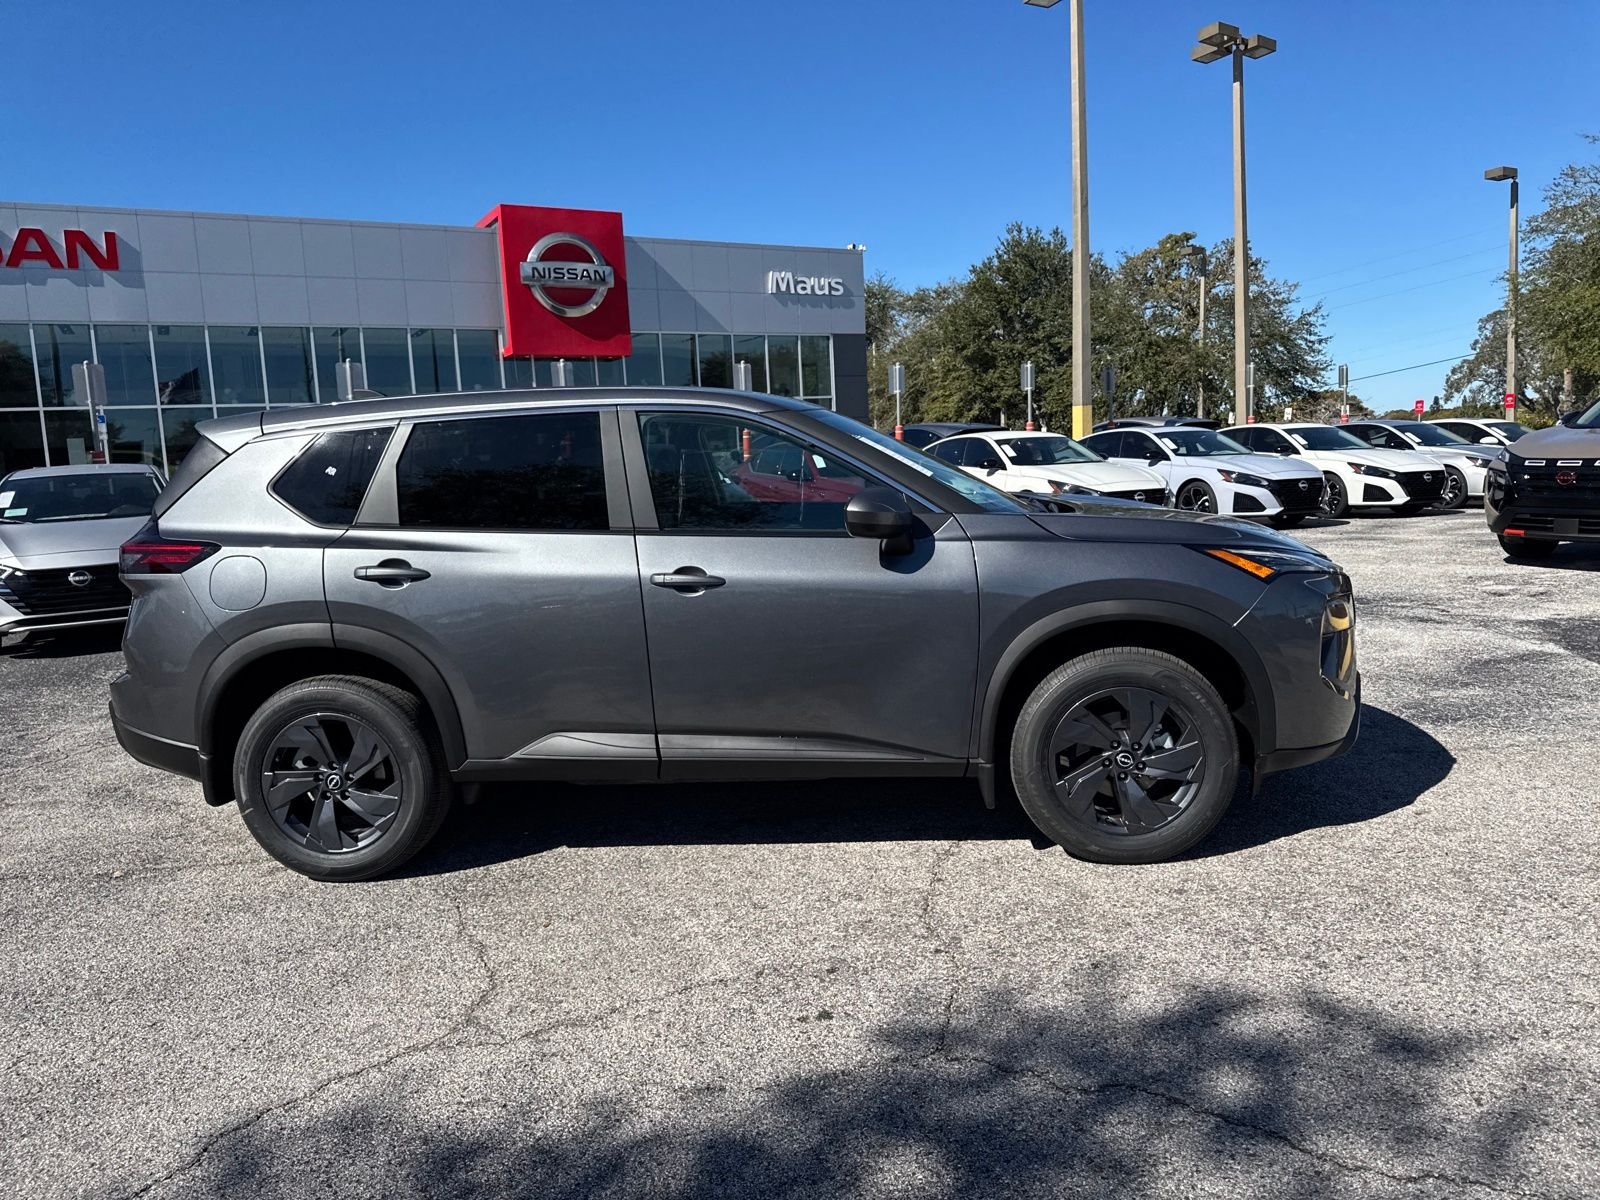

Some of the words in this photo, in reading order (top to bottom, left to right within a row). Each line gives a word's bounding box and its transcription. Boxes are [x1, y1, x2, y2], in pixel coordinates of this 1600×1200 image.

[0, 227, 119, 271] AN
[531, 266, 606, 282] NISSAN
[768, 270, 844, 296] Maus
